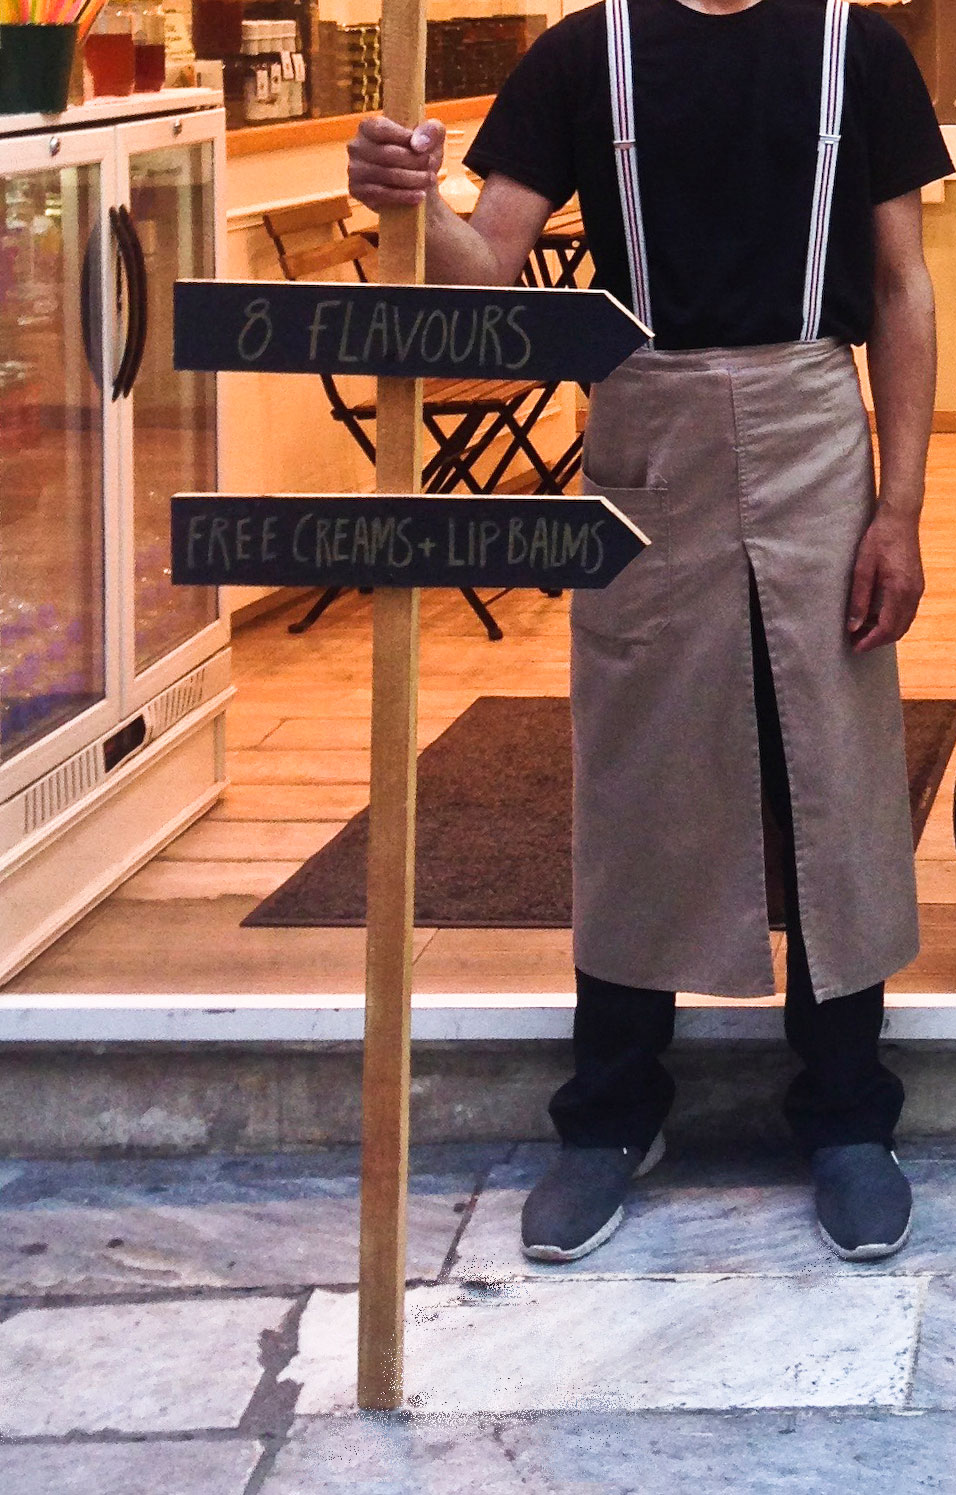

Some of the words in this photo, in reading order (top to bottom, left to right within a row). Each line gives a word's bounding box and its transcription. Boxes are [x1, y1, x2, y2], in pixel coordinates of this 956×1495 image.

[238, 297, 274, 363] 8
[308, 299, 532, 371] FLAVOURS
[186, 514, 278, 570] FREE
[292, 514, 414, 569] CREAMS
[447, 519, 500, 569] LIP
[506, 517, 606, 574] BALMS
